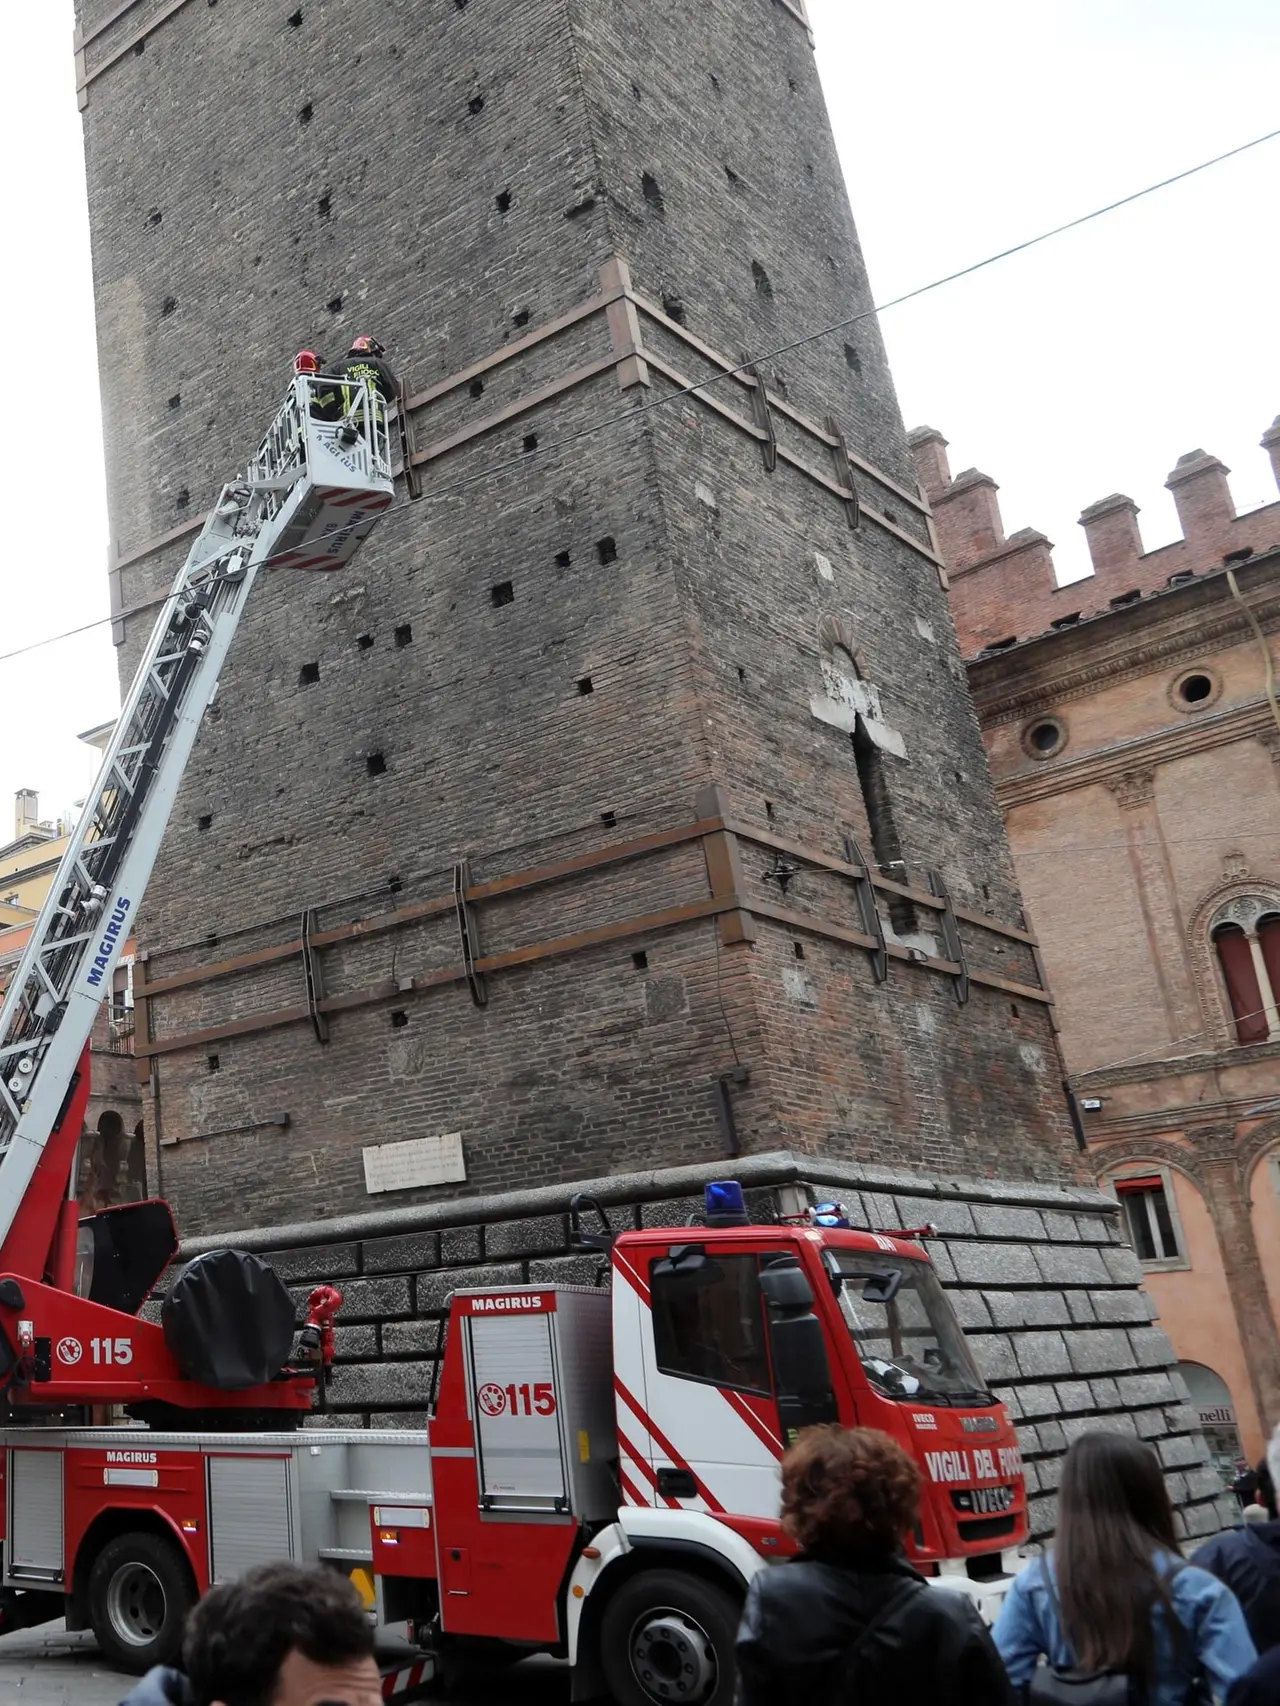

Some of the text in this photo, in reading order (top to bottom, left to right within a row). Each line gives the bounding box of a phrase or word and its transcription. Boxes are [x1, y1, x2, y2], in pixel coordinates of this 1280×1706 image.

[347, 363, 369, 373] VIGILI
[86, 896, 131, 987] MAGIRUS
[471, 1296, 542, 1311] MAGIRUS
[89, 1337, 133, 1365] 115
[505, 1383, 557, 1416] 115
[912, 1413, 936, 1423] IVECO
[106, 1451, 157, 1464] MAGIRUS
[924, 1450, 970, 1482] VIGILI
[972, 1448, 999, 1479] DEL
[969, 1486, 1013, 1515] IVECO
